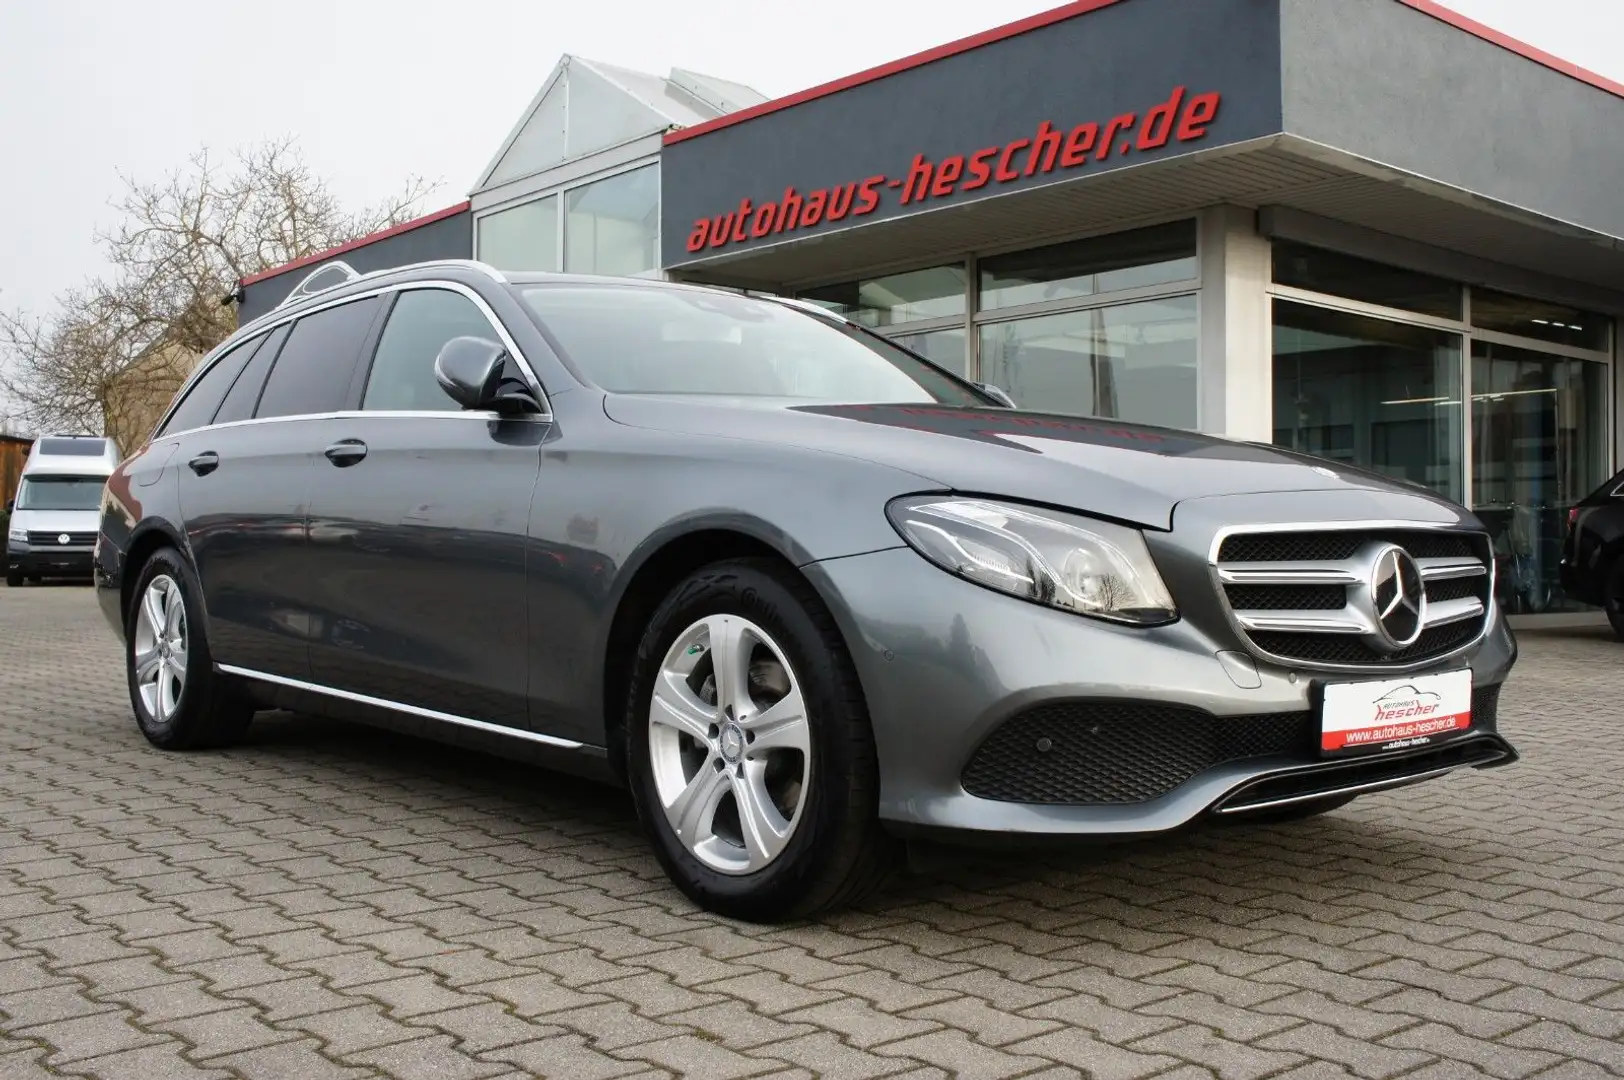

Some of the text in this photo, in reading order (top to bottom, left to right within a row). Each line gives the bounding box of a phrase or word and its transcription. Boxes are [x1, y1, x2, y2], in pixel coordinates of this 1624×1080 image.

[686, 85, 1220, 253] autohaus-hescher.de
[1375, 700, 1439, 721] hescher
[1383, 700, 1415, 710] AUTOHAUS
[1346, 716, 1456, 743] www.autohaus-hescher.de
